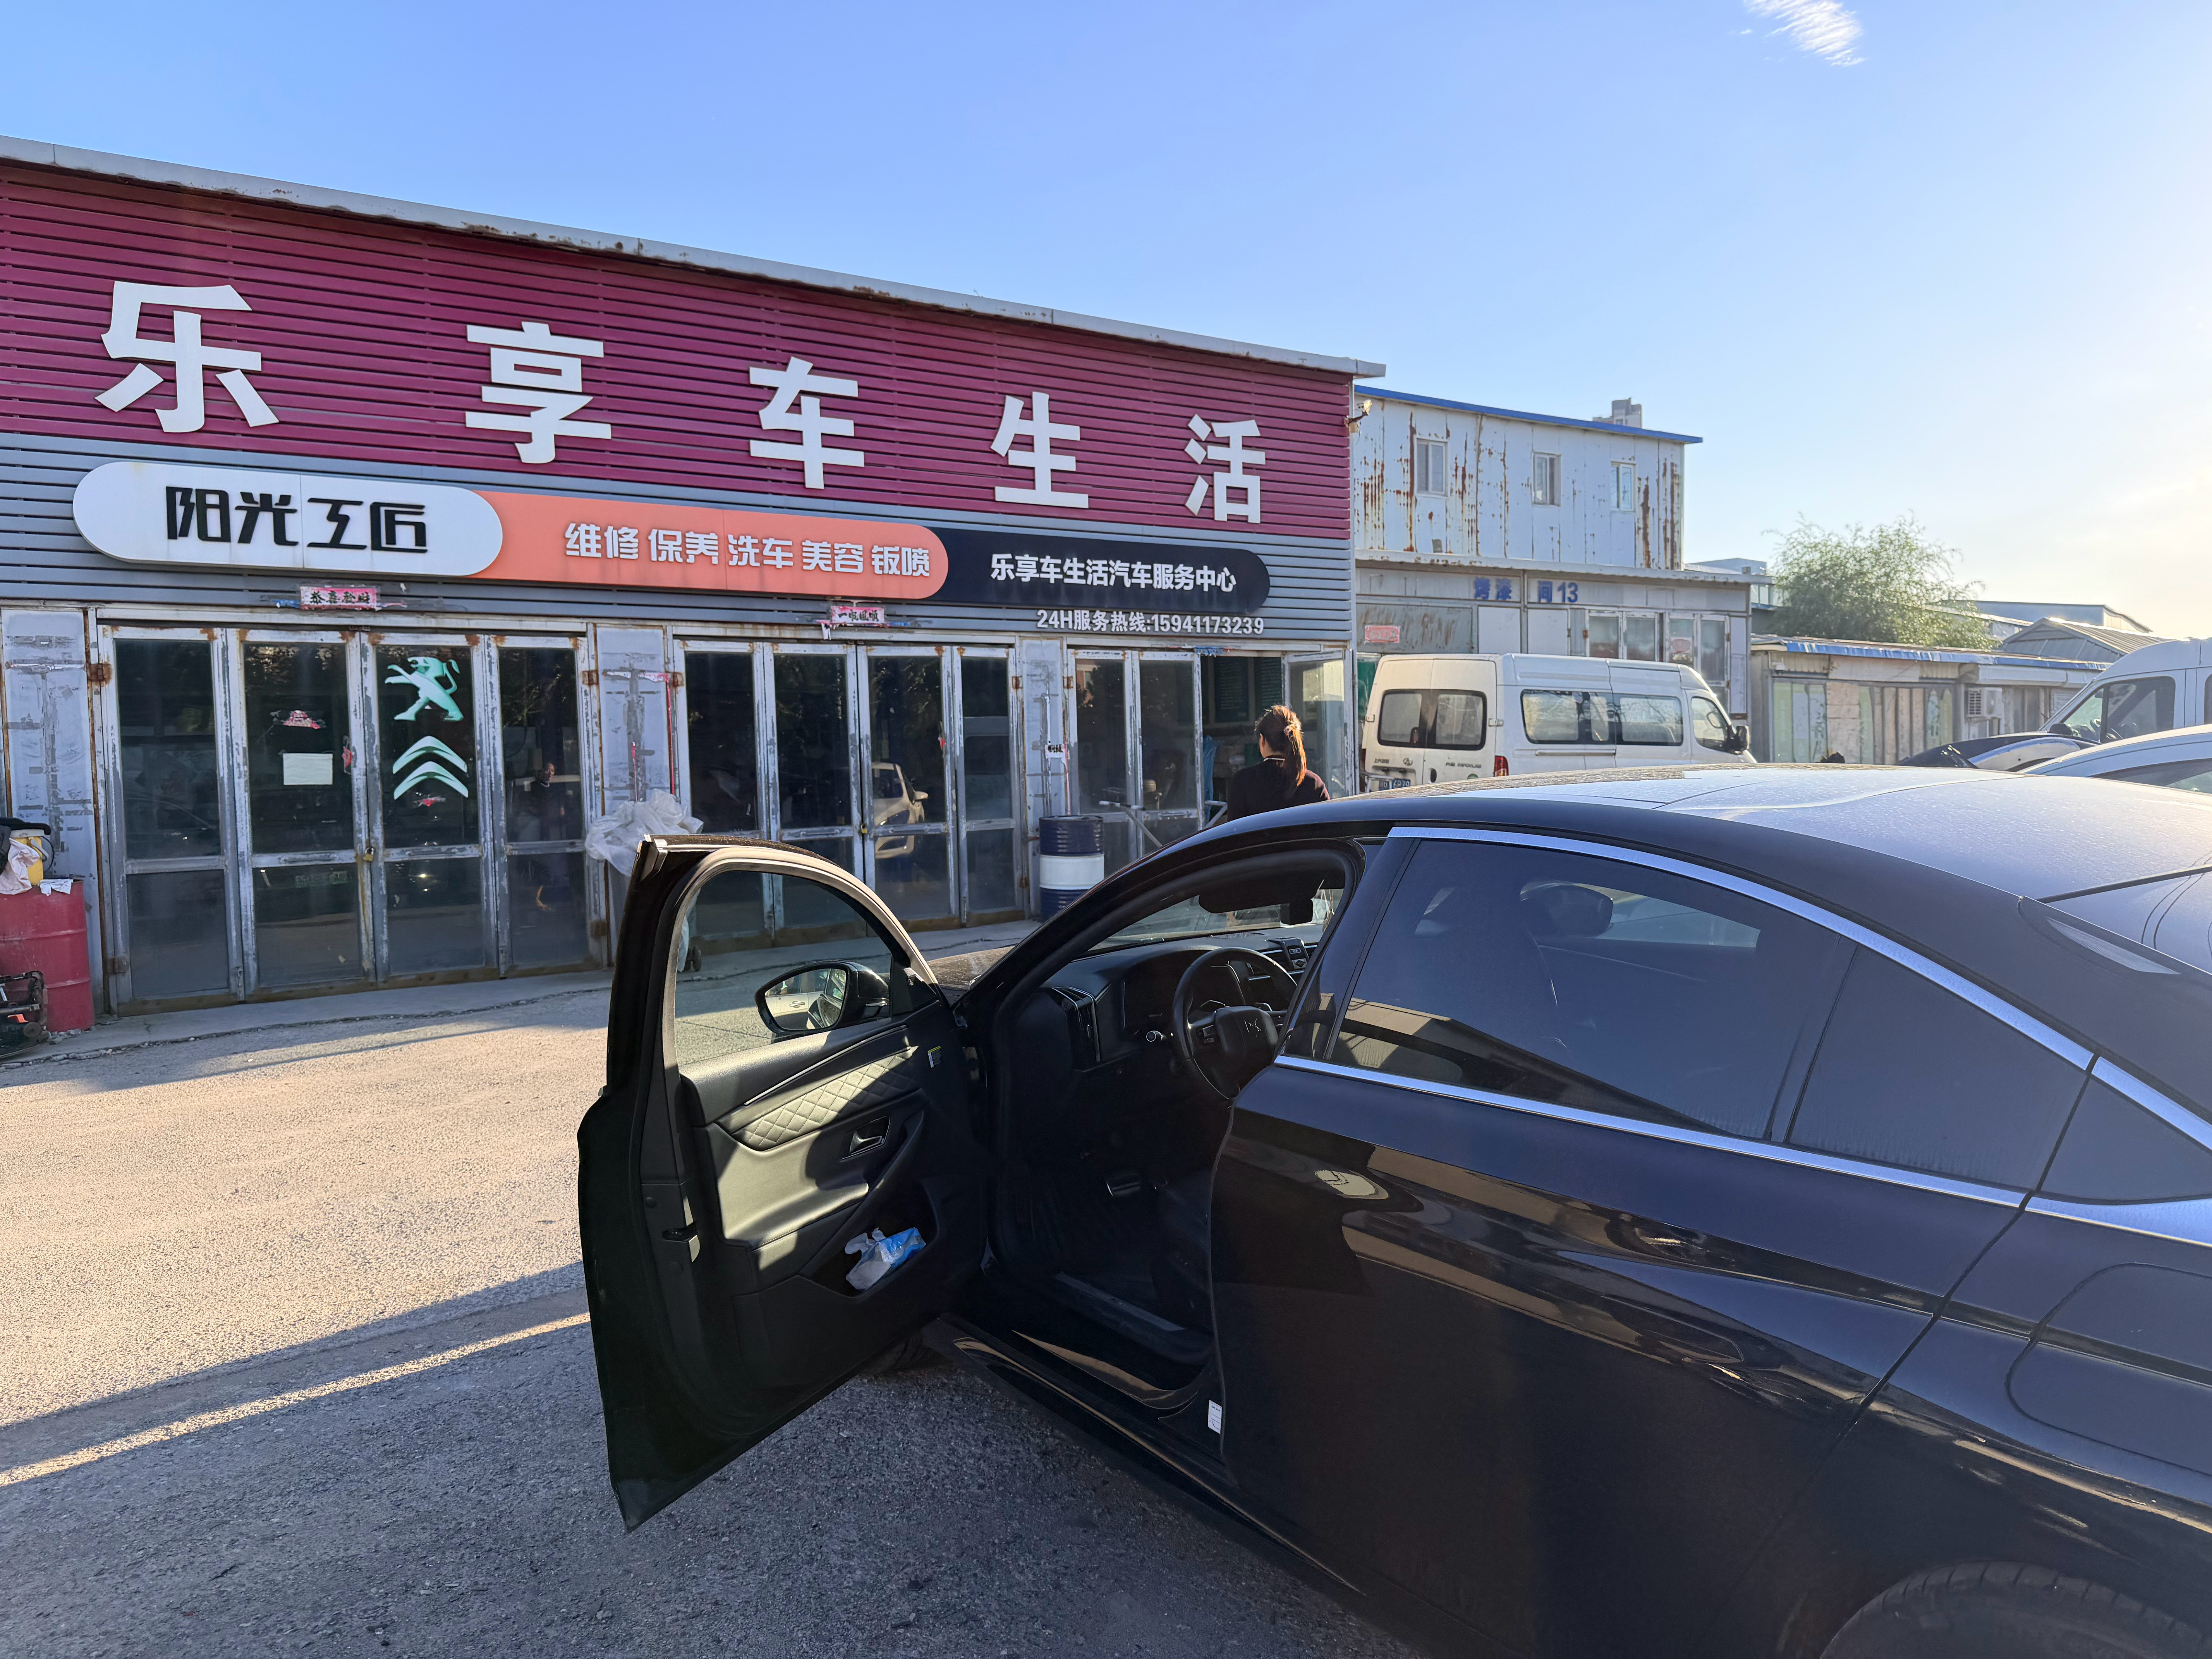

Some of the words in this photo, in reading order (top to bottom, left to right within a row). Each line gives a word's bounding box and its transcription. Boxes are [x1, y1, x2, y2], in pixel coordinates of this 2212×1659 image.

[95, 281, 1266, 524] 乐享车生活
[166, 486, 428, 553] 阳光工匠
[565, 523, 639, 560] 维修
[648, 529, 719, 565] 保养
[728, 534, 793, 569] 洗车
[802, 539, 864, 574] 美容
[871, 544, 930, 577] 钣喷
[990, 554, 1237, 592] 乐享车生活汽车服务中心
[1037, 610, 1264, 634] 24H服务热线:15941173239
